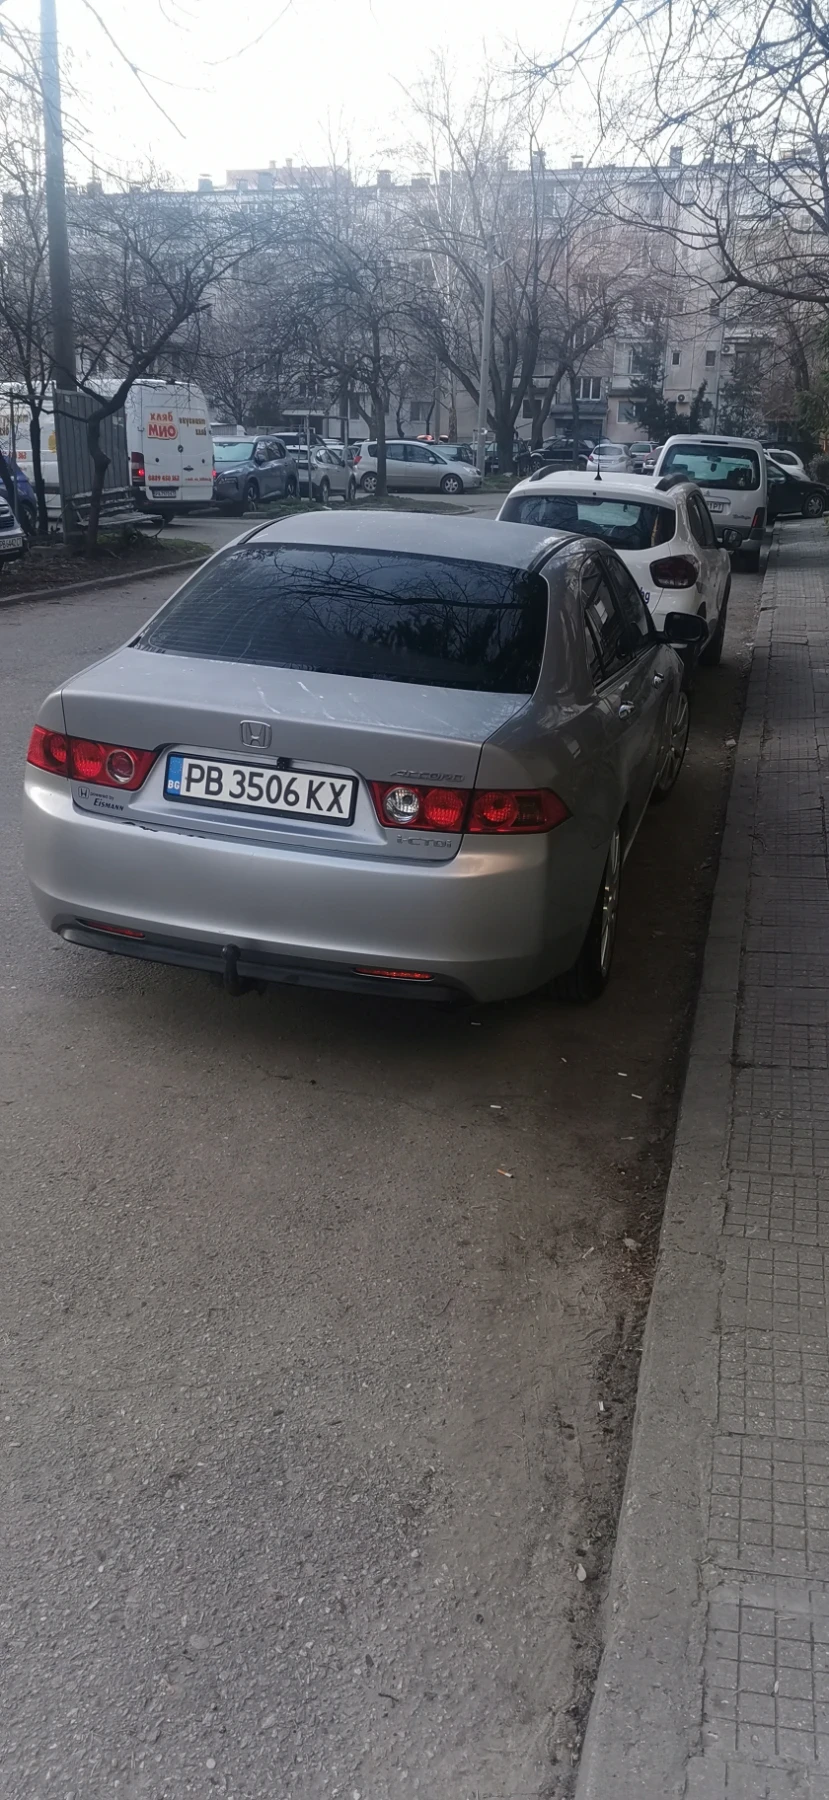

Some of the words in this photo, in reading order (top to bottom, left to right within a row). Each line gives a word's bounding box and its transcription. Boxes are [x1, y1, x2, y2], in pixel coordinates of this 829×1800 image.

[148, 424, 177, 438] МИО
[390, 769, 465, 782] ACCORD
[168, 779, 180, 790] BG
[185, 763, 224, 796] PB
[229, 769, 300, 807] 3506
[306, 779, 347, 814] KX
